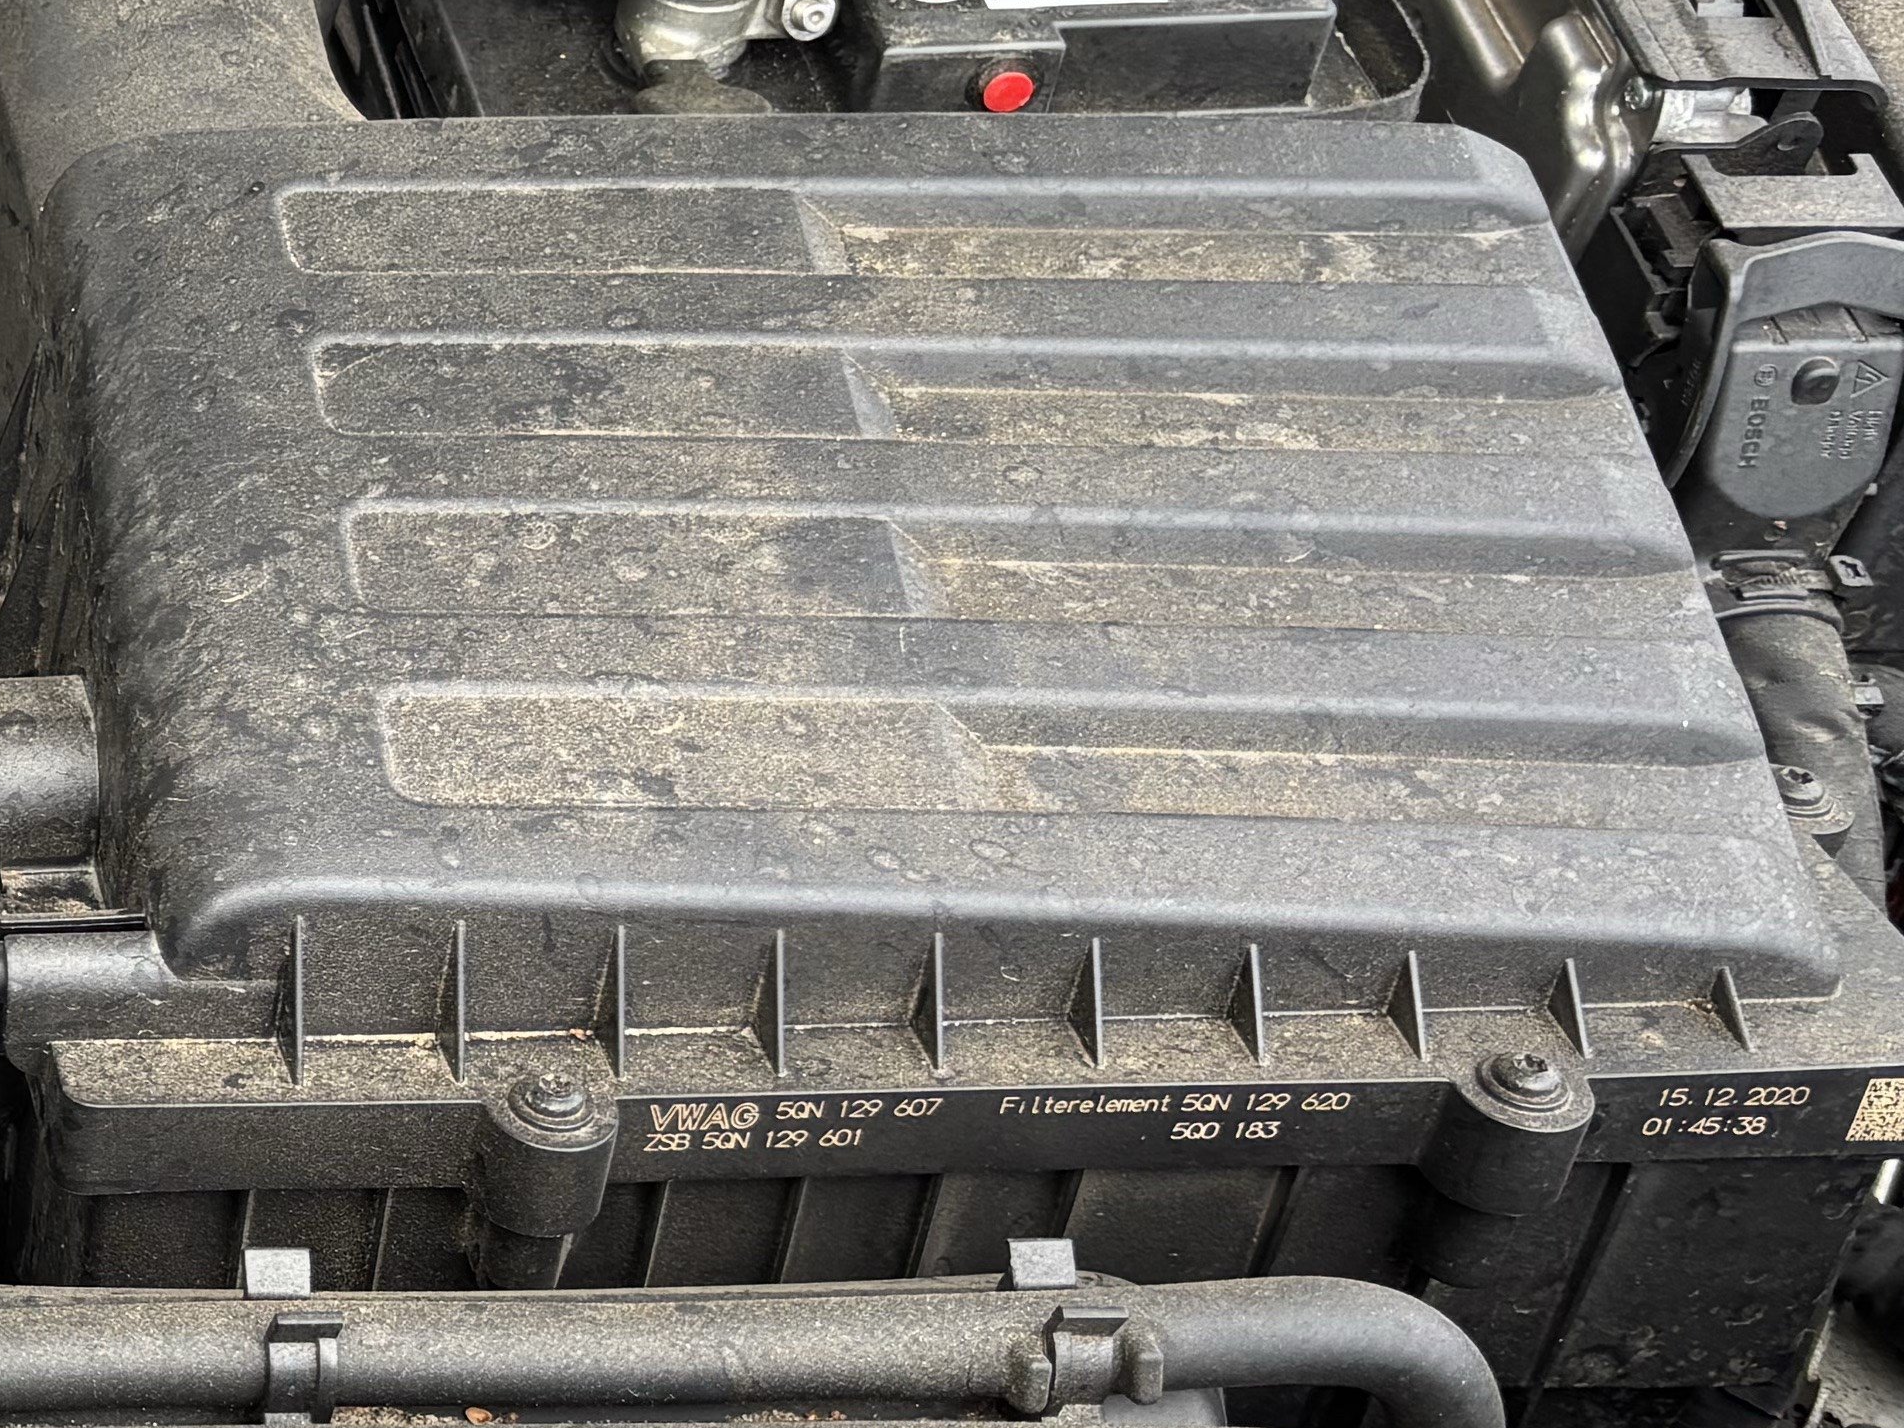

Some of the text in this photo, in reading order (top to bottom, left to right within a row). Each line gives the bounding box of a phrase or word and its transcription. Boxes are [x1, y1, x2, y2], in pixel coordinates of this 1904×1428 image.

[775, 1100, 825, 1118] 5QN
[839, 1098, 882, 1117] 129
[894, 1097, 944, 1117] 607
[999, 1091, 1352, 1115] Filterelement 5QN 129 620
[1641, 1115, 1768, 1137] 01:45:38
[643, 1128, 863, 1152] ZSB 5QN 129 601
